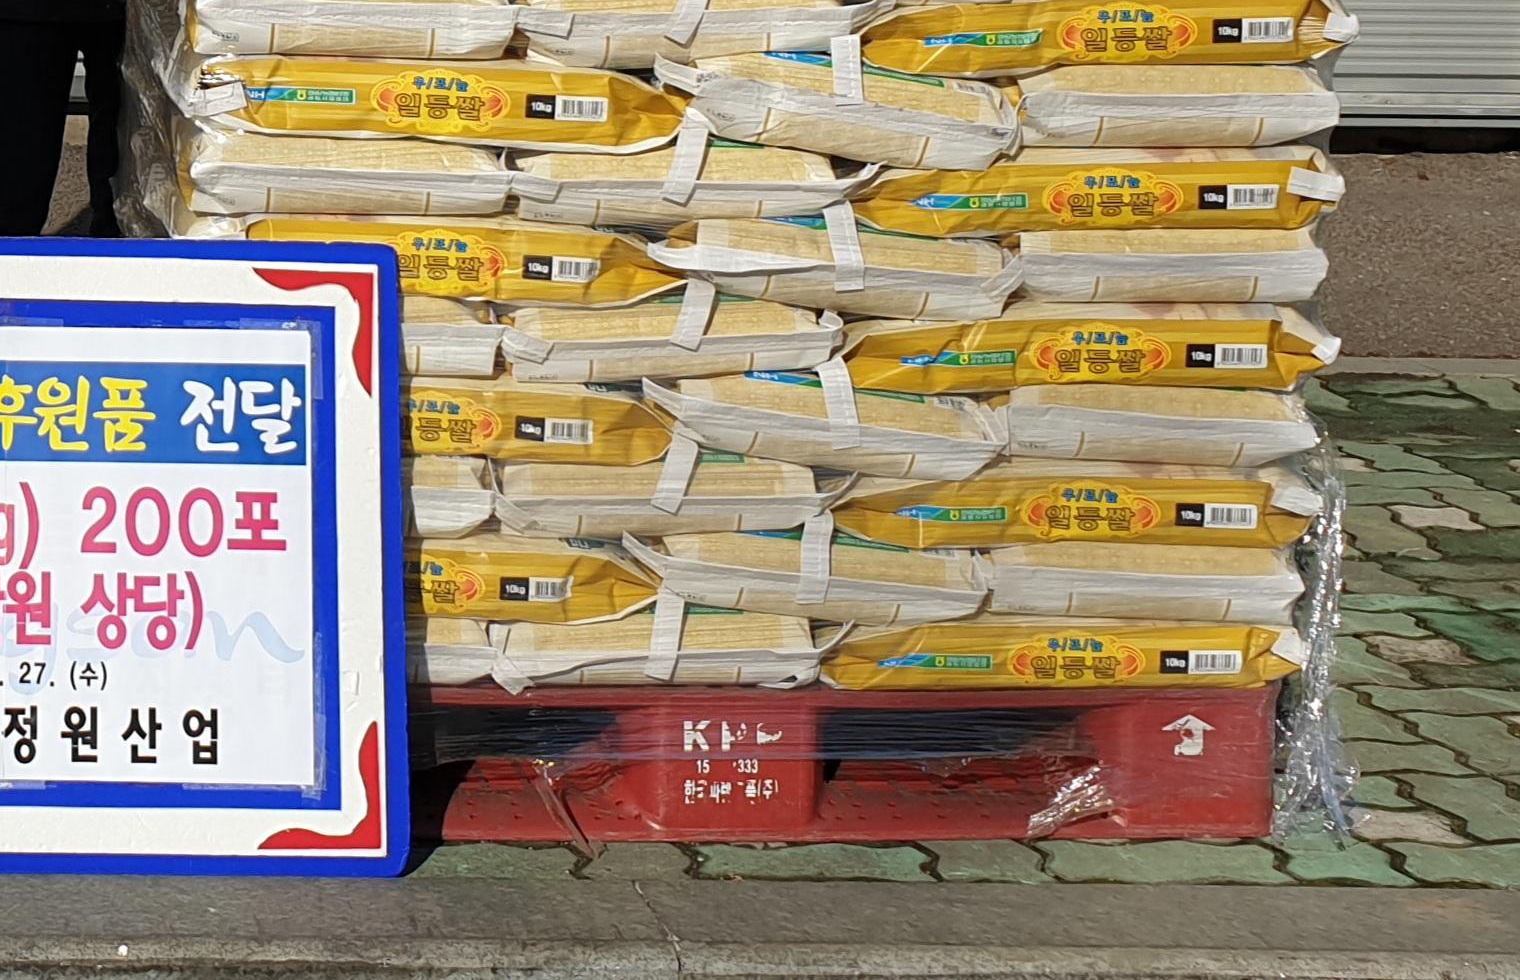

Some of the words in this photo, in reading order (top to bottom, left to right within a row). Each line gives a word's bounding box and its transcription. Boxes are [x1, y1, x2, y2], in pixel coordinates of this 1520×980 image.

[1081, 25, 1173, 52] 일등쌀
[394, 93, 486, 121] 일등쌀
[1067, 191, 1160, 218] 일등쌀
[1054, 349, 1146, 375] 일등쌀
[181, 377, 301, 455] 전달
[79, 485, 288, 557] 200포
[1045, 505, 1136, 532] 일등쌀
[79, 570, 205, 650] 상당)
[69, 660, 109, 691] (수)
[1030, 654, 1121, 680] 일등쌀
